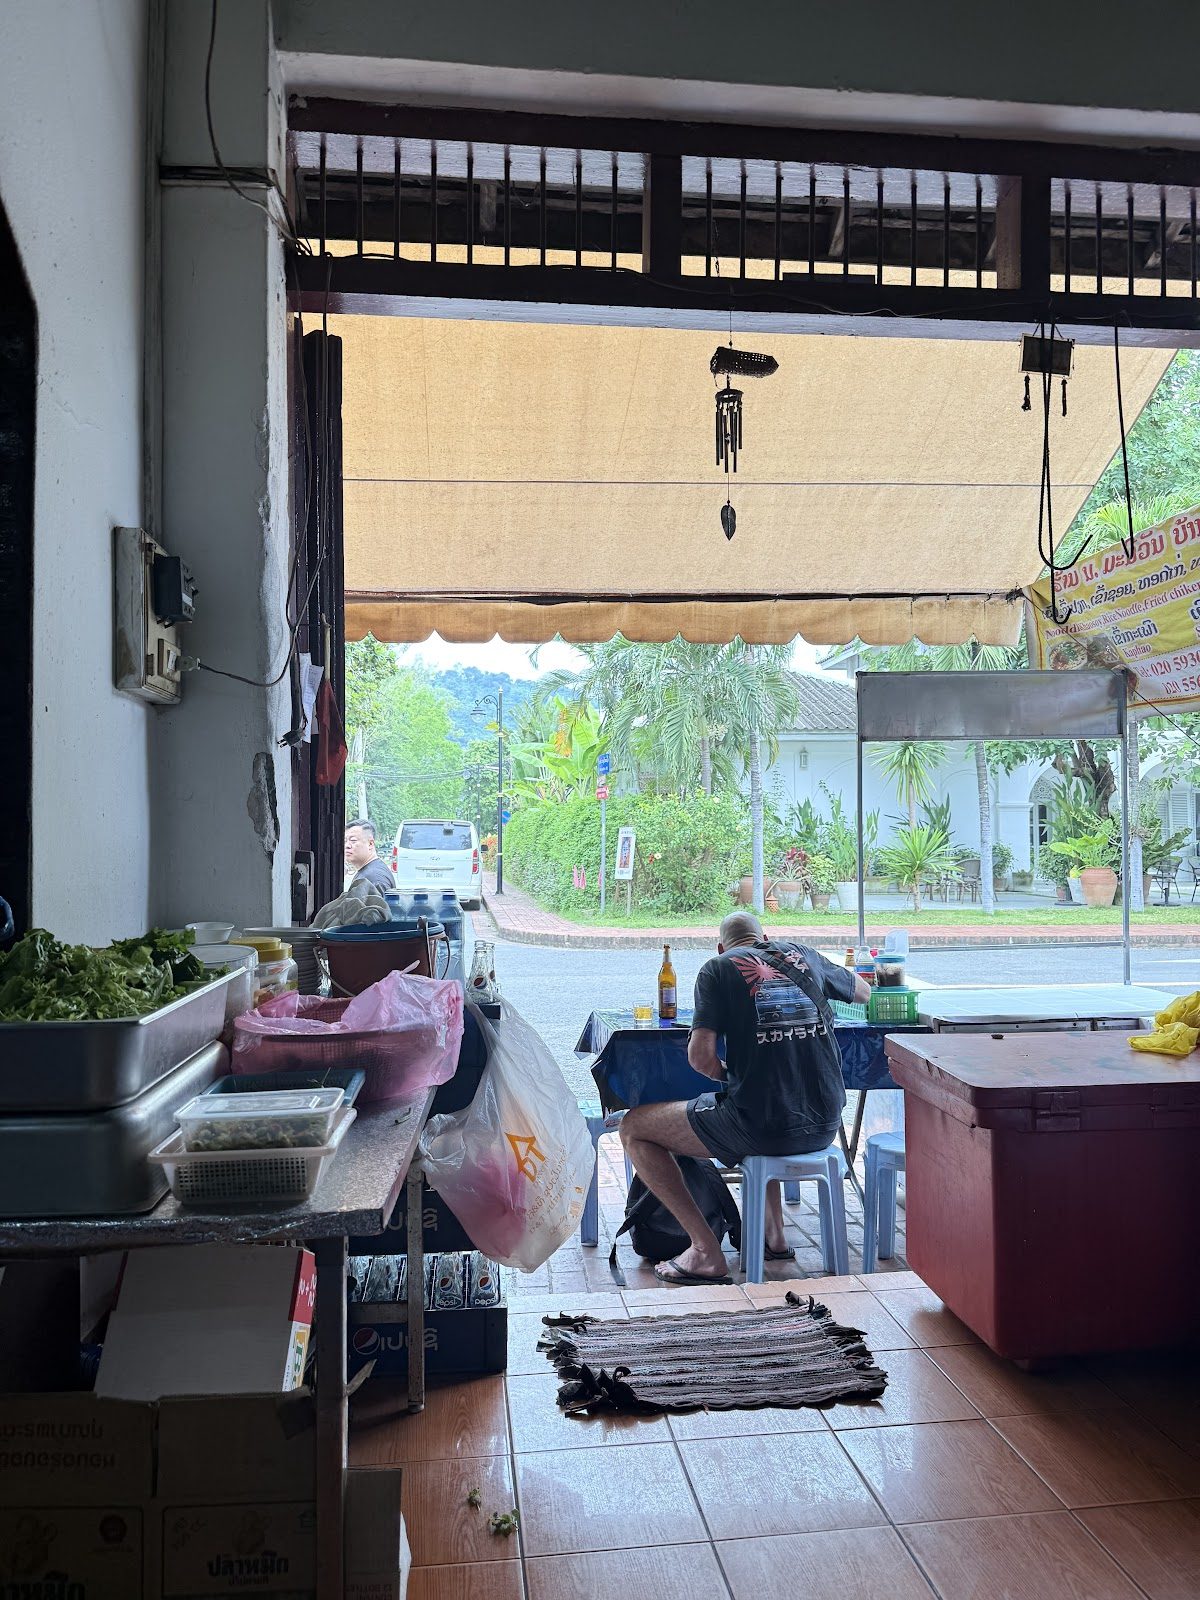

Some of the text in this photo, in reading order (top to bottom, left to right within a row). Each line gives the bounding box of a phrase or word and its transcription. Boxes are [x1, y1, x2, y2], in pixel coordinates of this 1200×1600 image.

[1122, 643, 1152, 660] Kaphao
[1150, 660, 1172, 677] 020
[1162, 680, 1182, 695] 020
